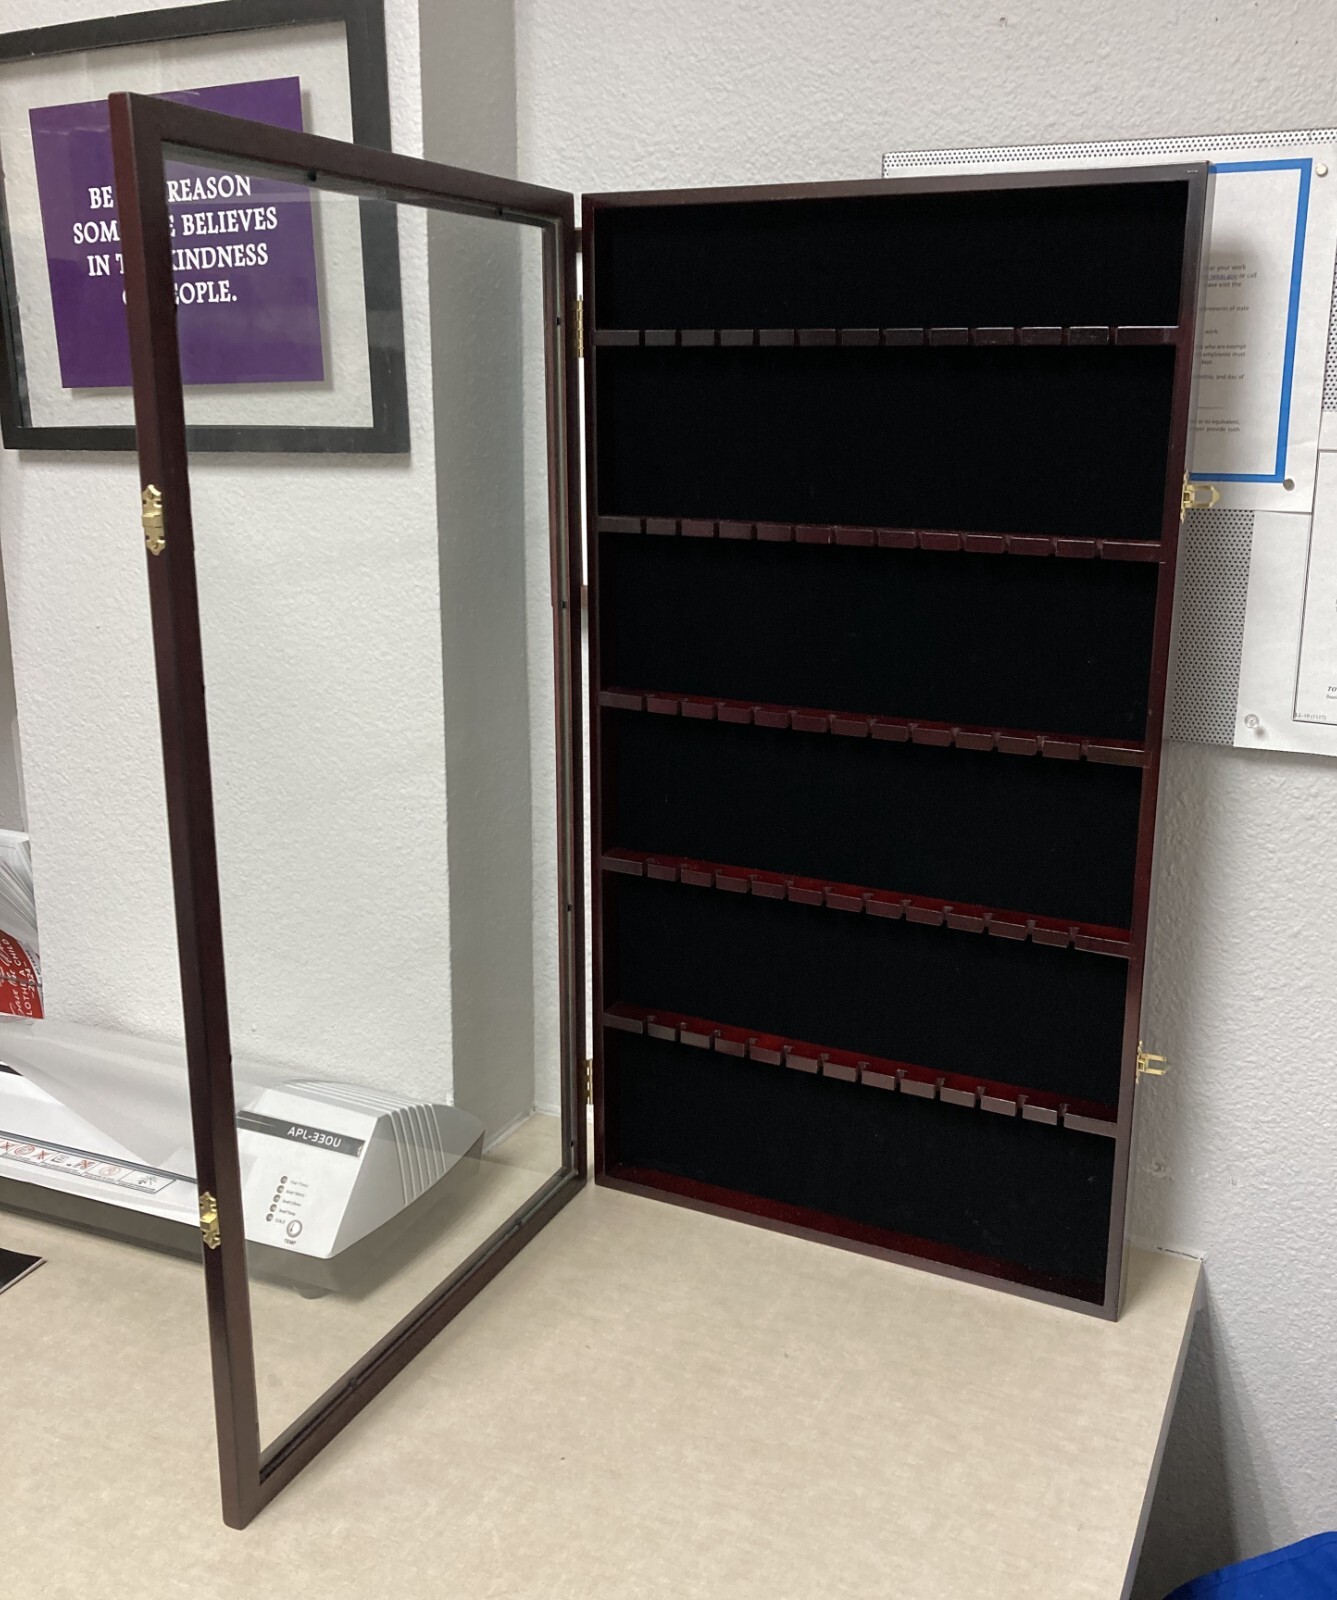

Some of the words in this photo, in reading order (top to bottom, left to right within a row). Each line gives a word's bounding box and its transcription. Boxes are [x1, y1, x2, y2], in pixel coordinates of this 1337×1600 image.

[88, 186, 114, 209] BE
[166, 174, 251, 202] REASON
[181, 206, 278, 236] BELIEVES
[87, 254, 110, 276] IN
[174, 279, 237, 305] OPLE.
[287, 1126, 342, 1148] APL-330U
